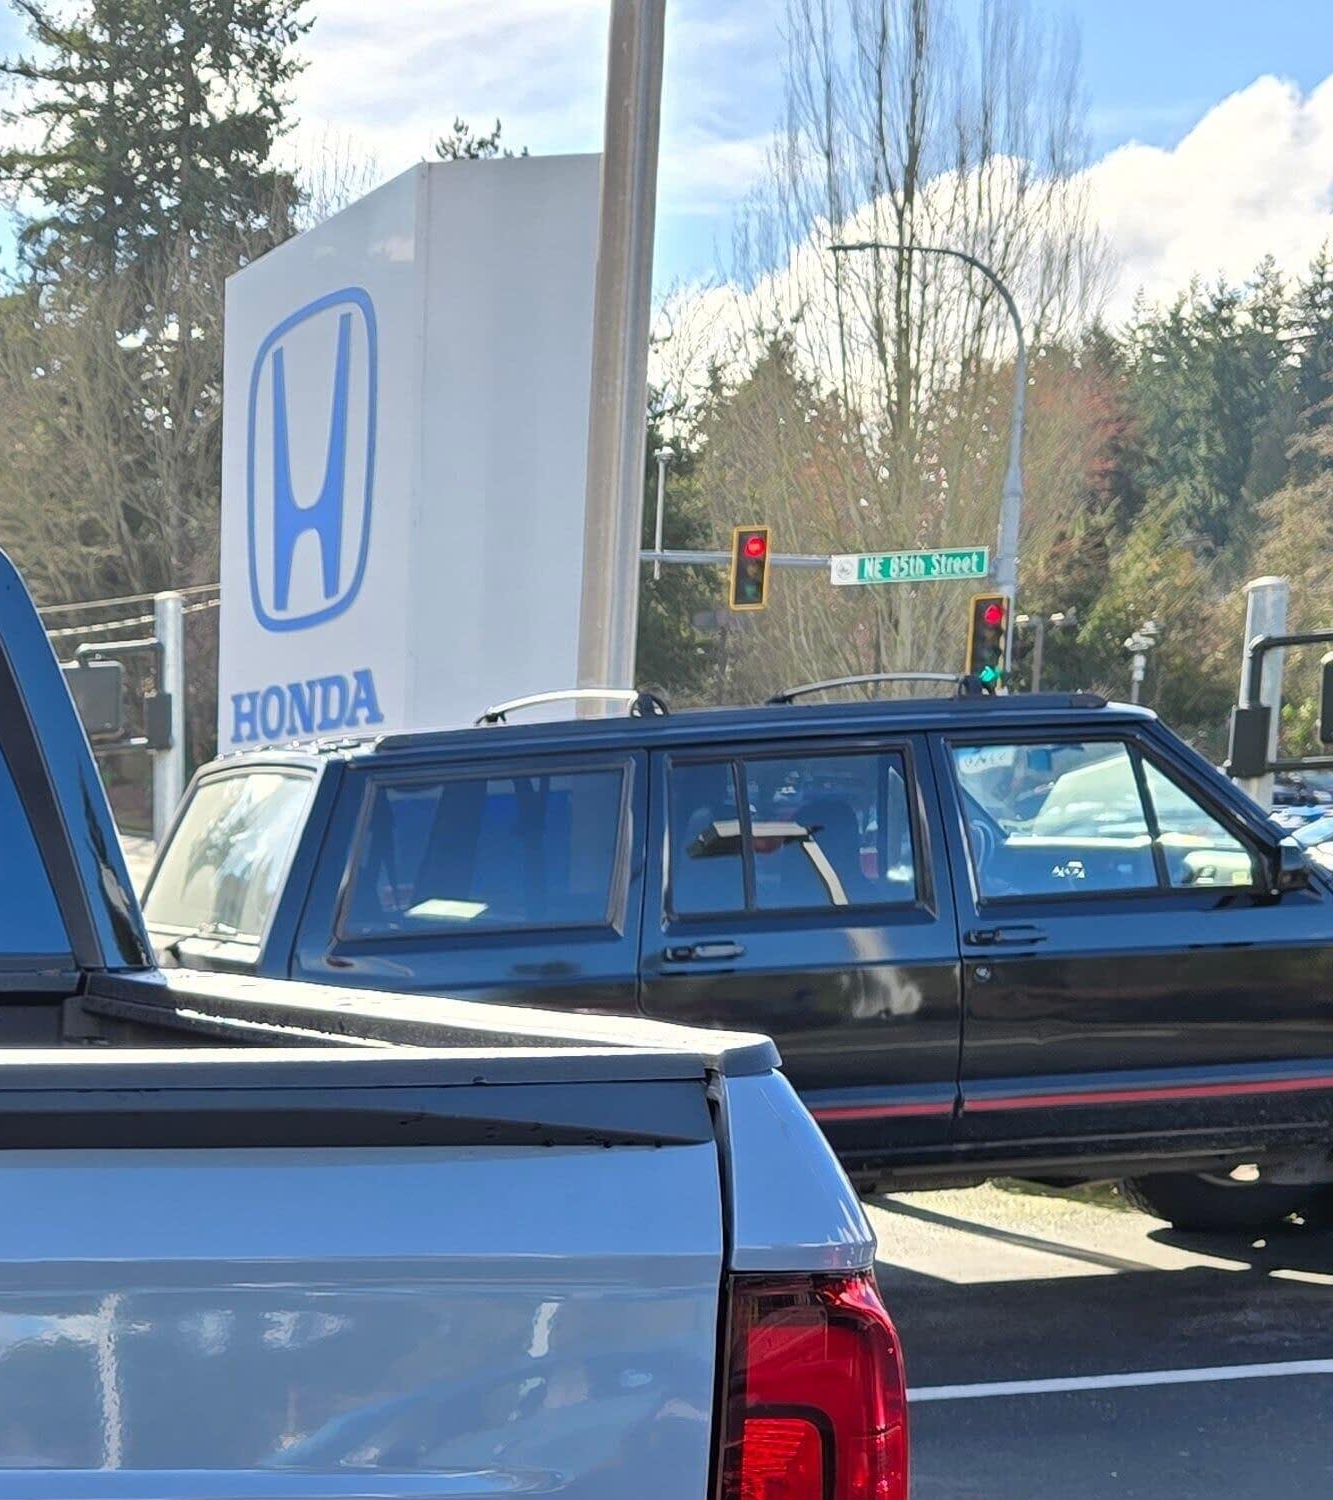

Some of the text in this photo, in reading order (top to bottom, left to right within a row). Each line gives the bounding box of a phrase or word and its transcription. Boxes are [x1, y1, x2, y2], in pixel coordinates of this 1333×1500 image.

[864, 550, 980, 579] NE 85th Street
[231, 668, 384, 744] HONDA
